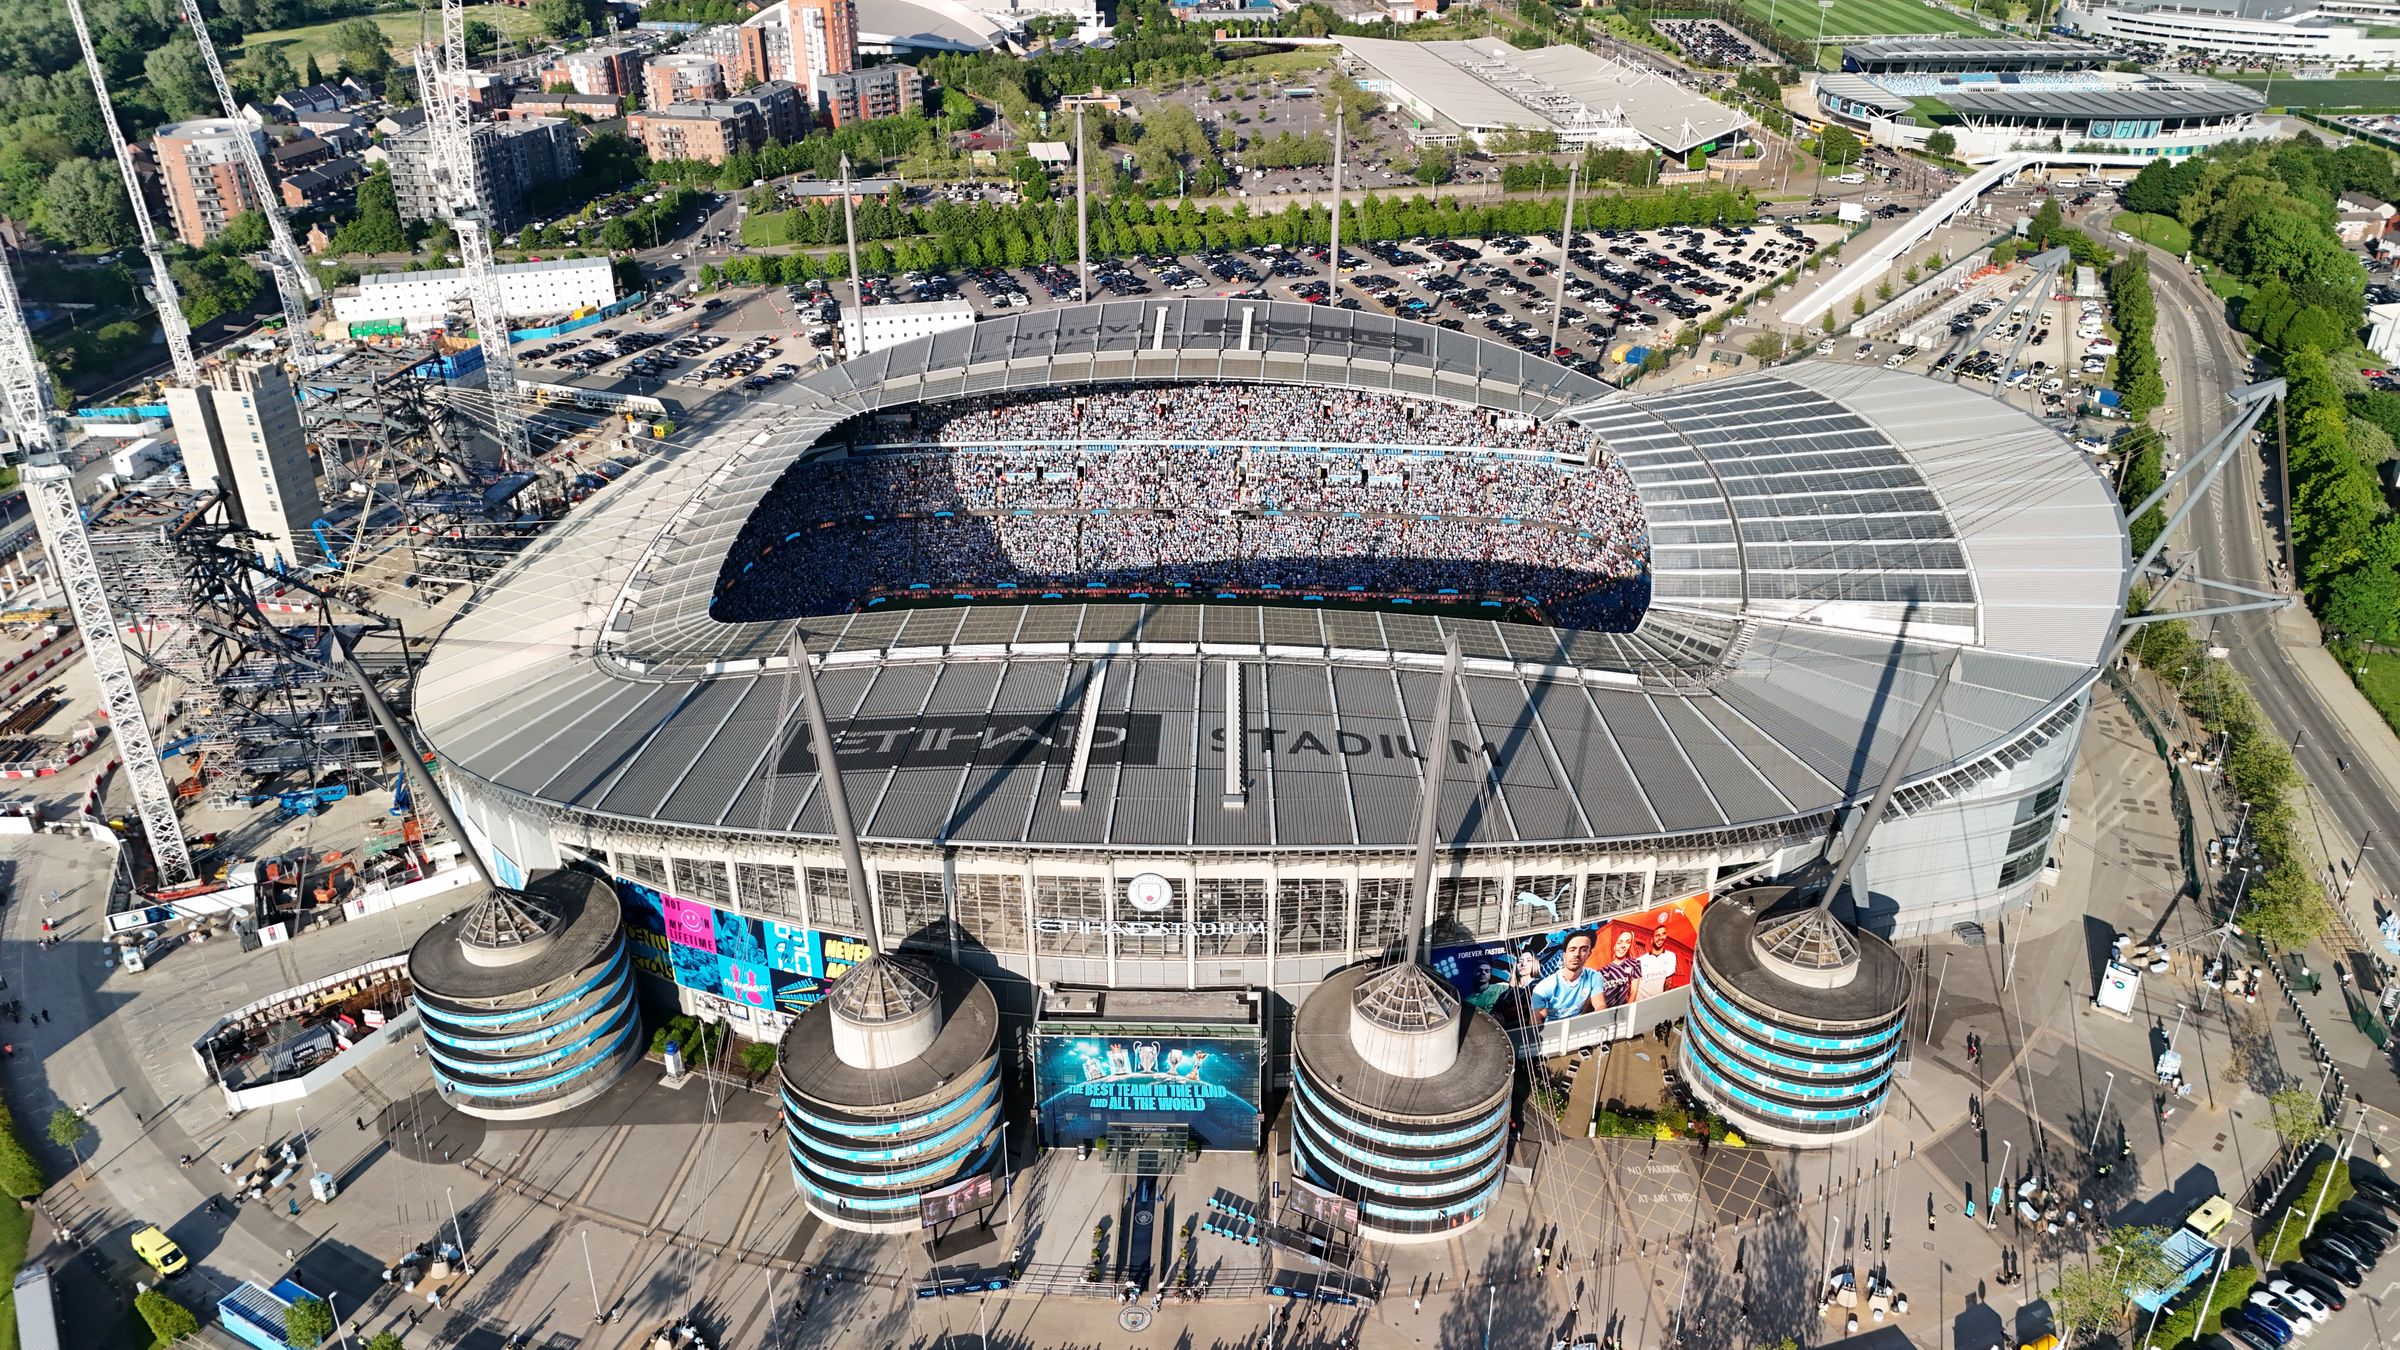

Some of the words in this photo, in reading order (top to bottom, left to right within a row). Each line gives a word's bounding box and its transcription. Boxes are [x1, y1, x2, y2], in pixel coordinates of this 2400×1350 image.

[2113, 120, 2160, 138] CITY
[806, 725, 1127, 754] ETIHAD
[665, 897, 681, 911] NOT
[669, 919, 683, 931] MY
[1036, 919, 1152, 936] ETIHAD
[1160, 921, 1265, 936] STADIUM
[670, 929, 713, 950] LIFETIME
[825, 940, 872, 962] NEVER
[1458, 950, 1482, 959] FOREVER.
[1484, 947, 1506, 956] FASTER.
[1069, 1084, 1084, 1094] THE
[1085, 1083, 1115, 1097] BEST
[1117, 1083, 1151, 1098] TEAM
[1154, 1084, 1168, 1097] IN
[1170, 1085, 1192, 1098] THE
[1194, 1085, 1227, 1099] LAND
[1090, 1098, 1108, 1108] AND
[1109, 1096, 1131, 1110] ALL
[1133, 1096, 1156, 1110] THE
[1158, 1097, 1206, 1111] WORLD
[1627, 1166, 1642, 1175] NO
[1647, 1164, 1680, 1174] PARKING
[1638, 1194, 1649, 1204] AT
[1653, 1194, 1668, 1203] ANY
[1671, 1193, 1693, 1202] TIME
